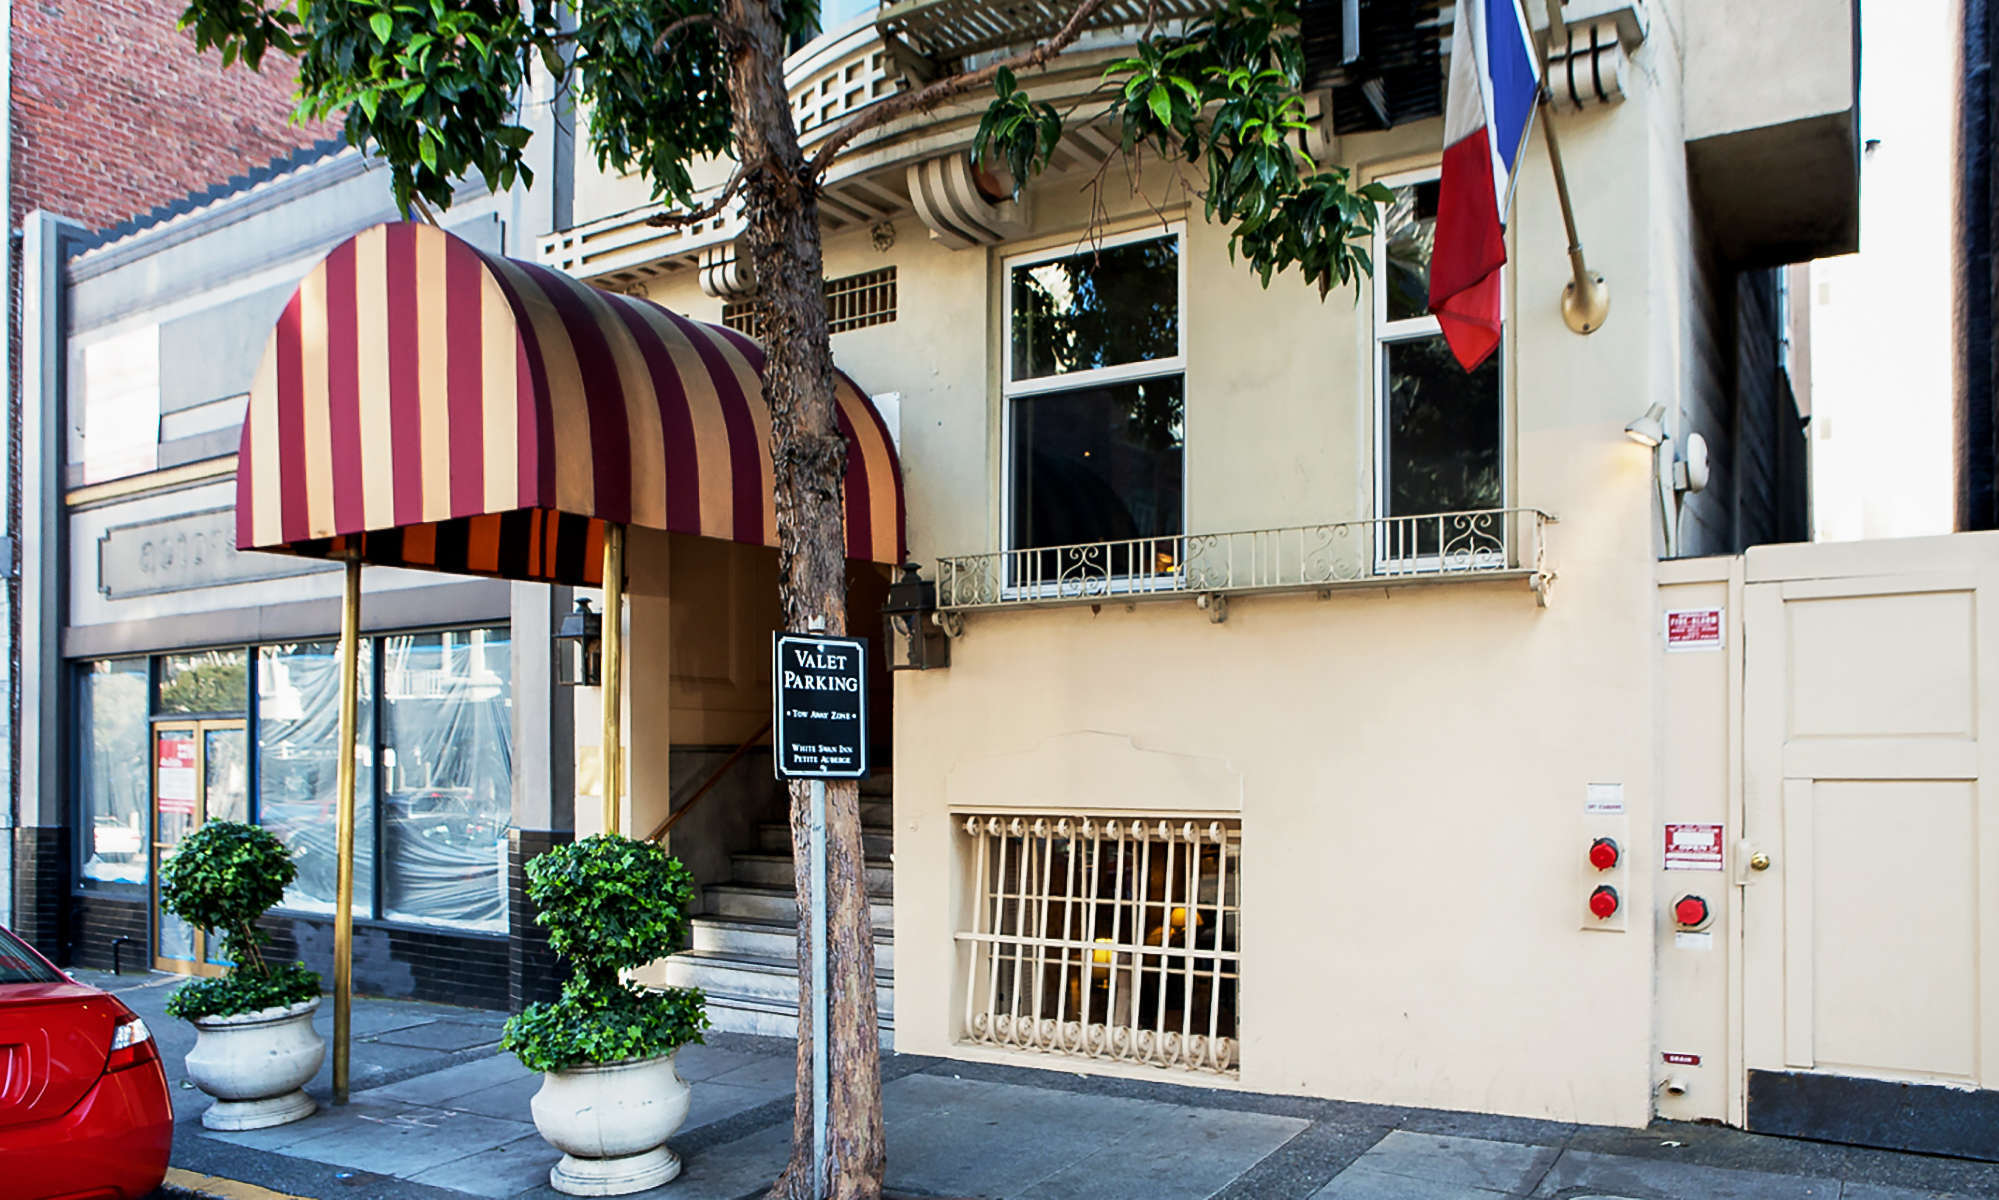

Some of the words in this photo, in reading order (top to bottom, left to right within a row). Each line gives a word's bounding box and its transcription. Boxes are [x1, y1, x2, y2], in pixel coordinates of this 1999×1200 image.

[794, 649, 848, 670] VALET
[784, 671, 858, 692] PARKING
[792, 709, 808, 719] TOW
[810, 710, 829, 720] AWAY
[831, 711, 851, 721] ZONE
[791, 743, 816, 753] WHITE
[839, 745, 853, 753] INN
[793, 754, 818, 764] PETITE
